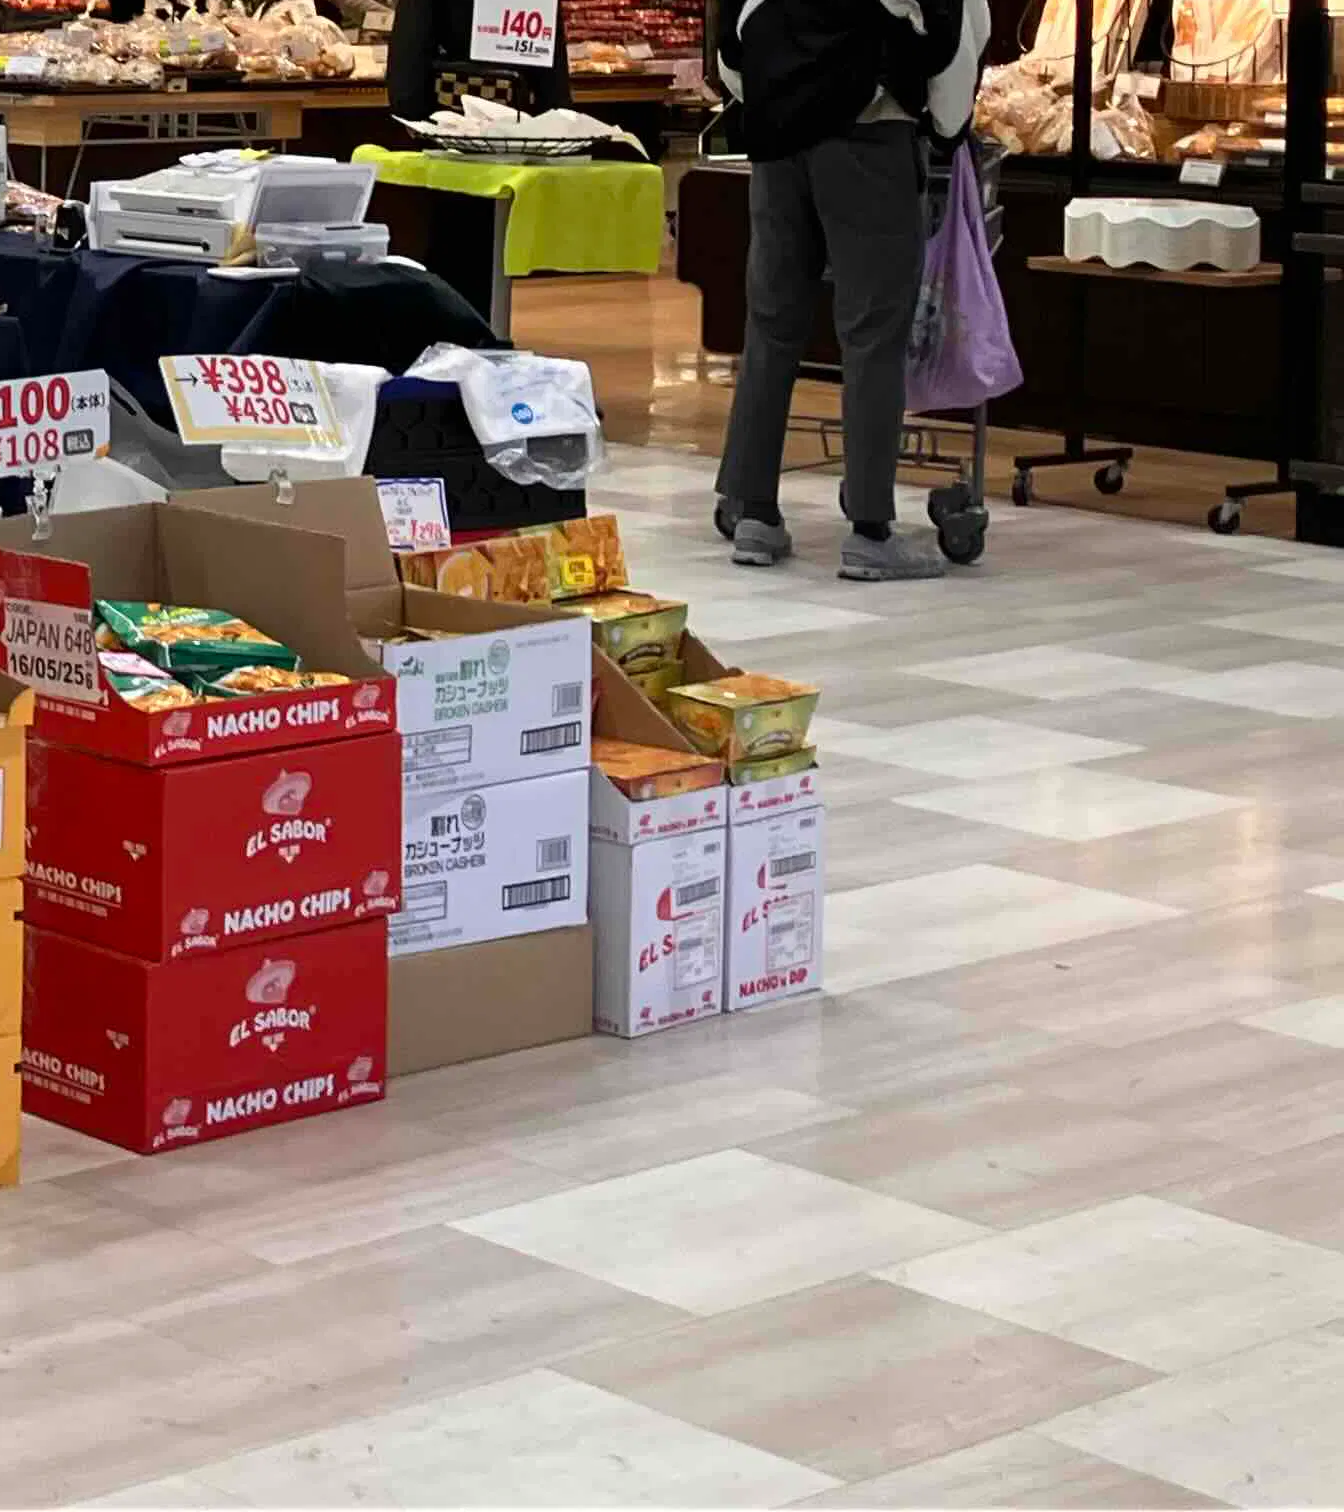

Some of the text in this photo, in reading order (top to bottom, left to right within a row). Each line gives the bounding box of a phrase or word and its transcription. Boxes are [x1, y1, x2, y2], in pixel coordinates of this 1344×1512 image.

[196, 357, 289, 396] ¥398
[221, 395, 291, 425] ¥430
[7, 616, 61, 650] JAPAN
[64, 625, 93, 656] 648
[10, 653, 85, 686] 16/05/25
[207, 697, 340, 739] NACHO CHIPS
[245, 819, 327, 858] EL SABOR
[404, 831, 486, 861] カシューナッツ
[23, 858, 78, 890] NACHO
[80, 875, 123, 905] CHIPS
[224, 887, 353, 937] NACHO CHIPS
[740, 904, 760, 934] EL
[638, 943, 659, 973] EL
[738, 975, 779, 999] NACHO
[788, 966, 809, 986] DIP
[229, 1006, 313, 1048] EL SABOR
[22, 1045, 63, 1075] ACHO
[65, 1062, 106, 1092] CHIPS
[205, 1073, 336, 1125] NACHO CHIPS
